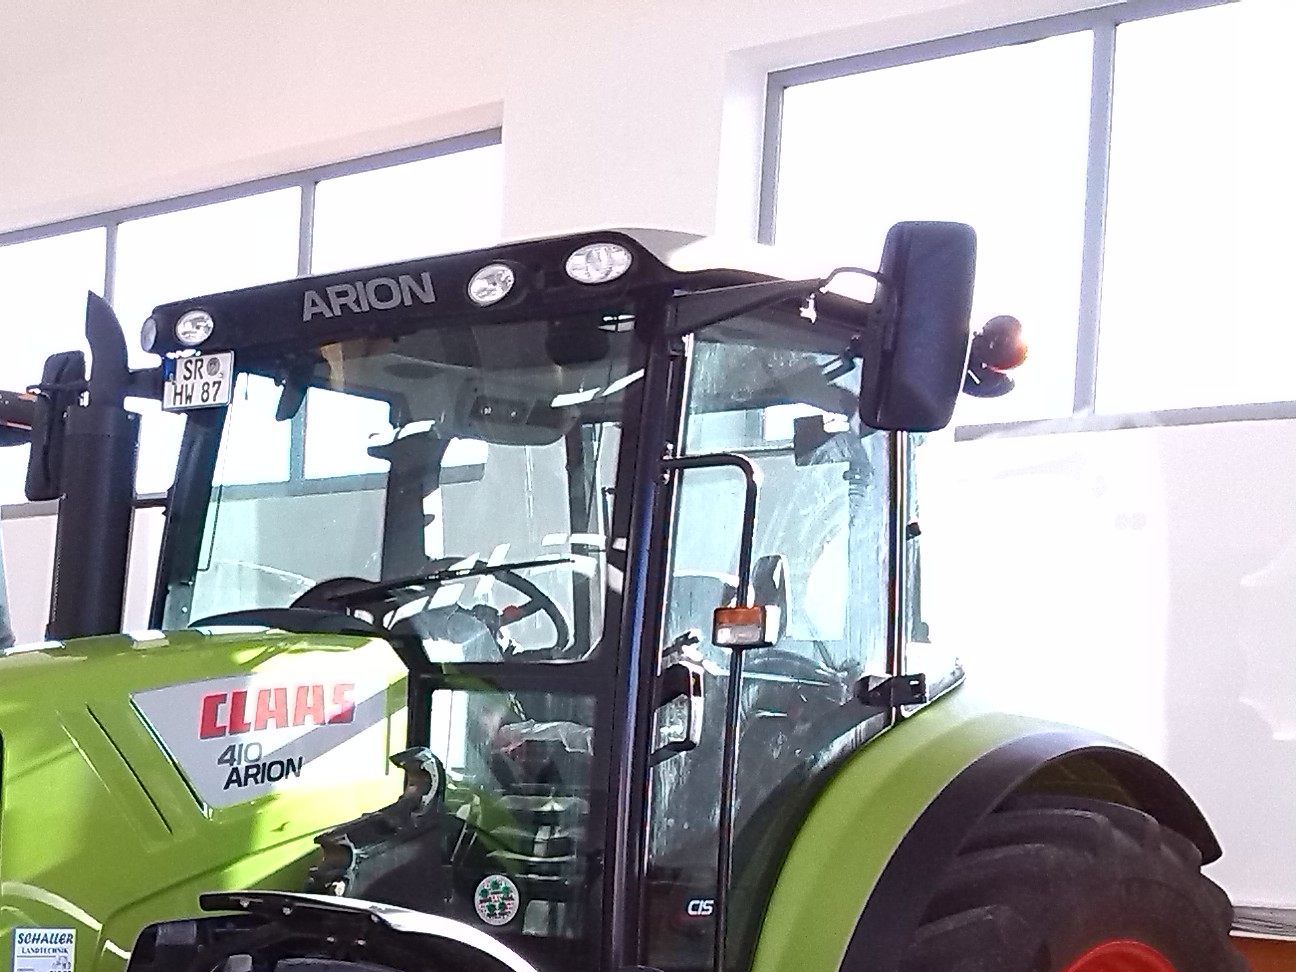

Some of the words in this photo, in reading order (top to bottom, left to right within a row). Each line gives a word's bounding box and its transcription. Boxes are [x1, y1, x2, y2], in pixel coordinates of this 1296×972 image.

[303, 271, 436, 321] ARION
[183, 358, 204, 381] SR
[173, 382, 195, 405] HW
[201, 380, 222, 403] 87
[199, 683, 356, 740] CLAAS
[217, 742, 263, 766] 410
[223, 757, 303, 790] ARION
[688, 900, 714, 915] CIS
[17, 932, 74, 945] SCHALLER
